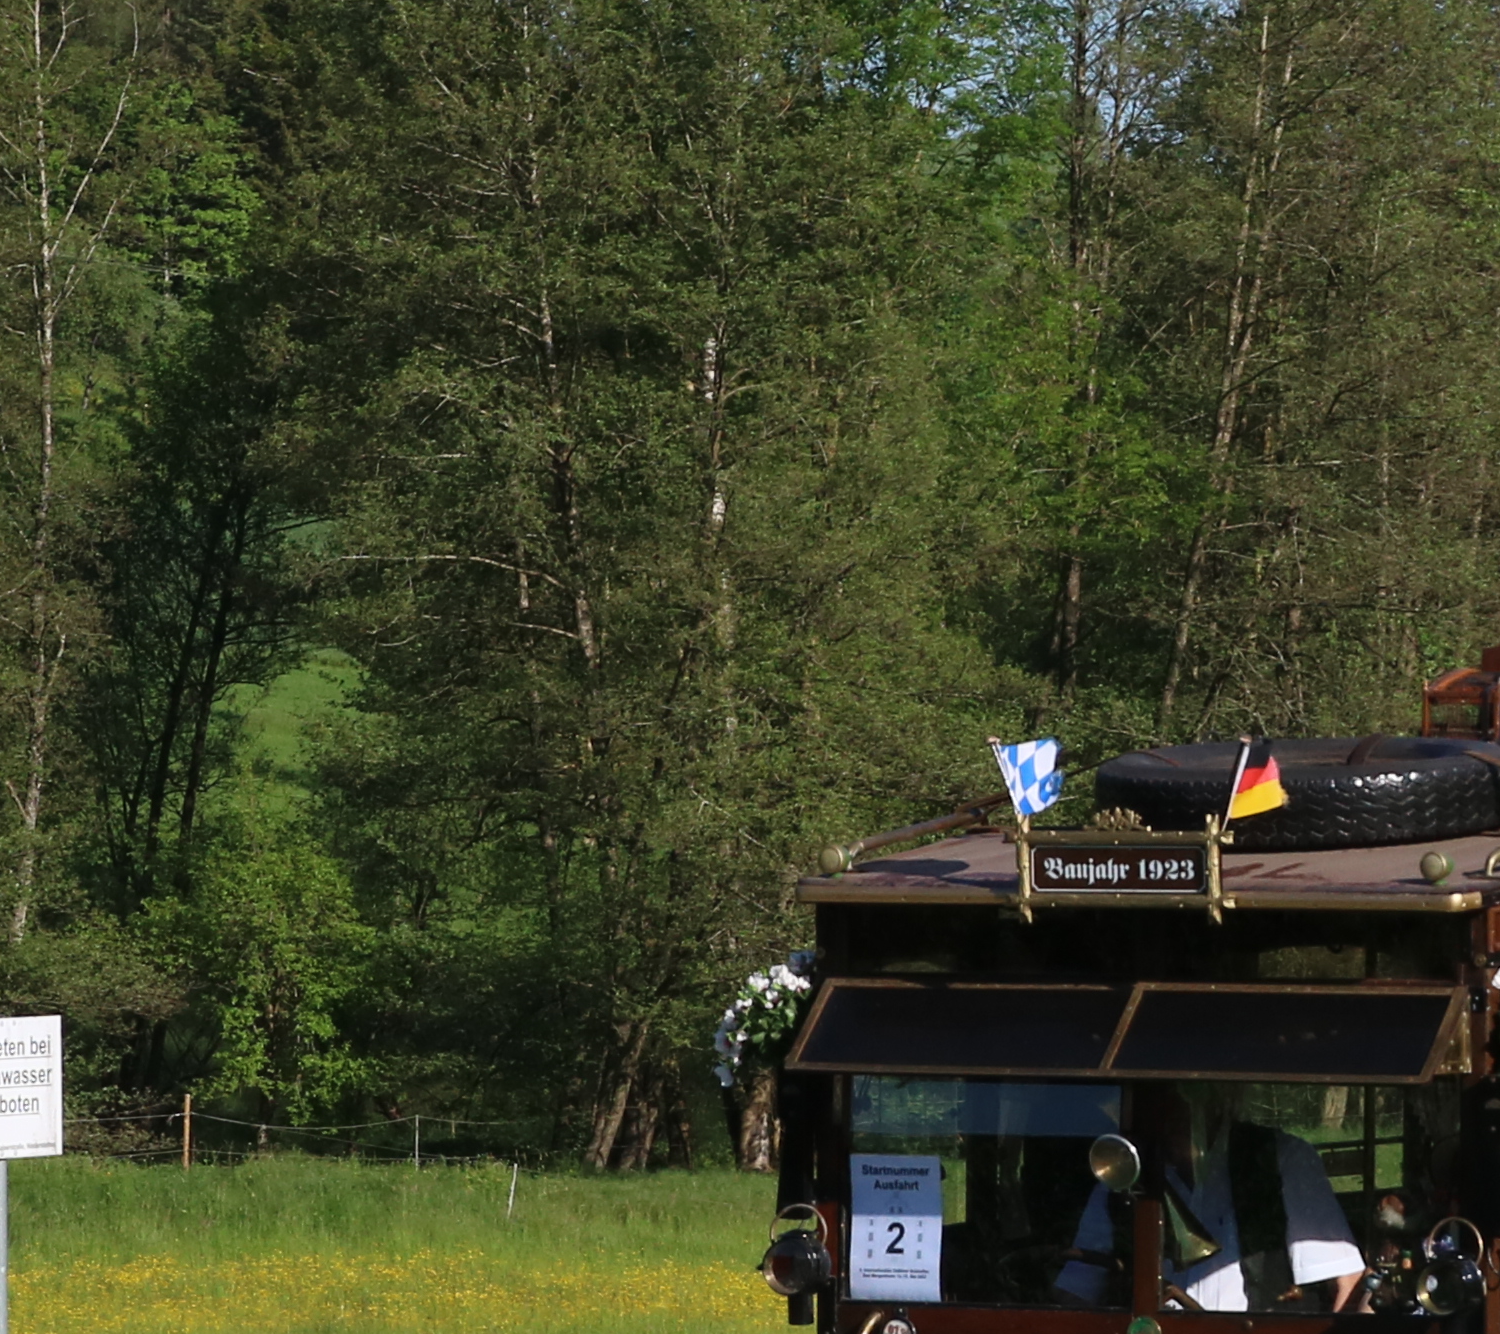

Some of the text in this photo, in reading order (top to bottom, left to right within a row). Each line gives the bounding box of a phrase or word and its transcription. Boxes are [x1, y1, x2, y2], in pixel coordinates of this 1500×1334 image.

[1043, 857, 1195, 885] Baujahr 1923
[30, 1035, 51, 1055] bei
[861, 1164, 930, 1176] Startnummer
[873, 1179, 919, 1191] Ausfahrt
[885, 1221, 905, 1255] 2
